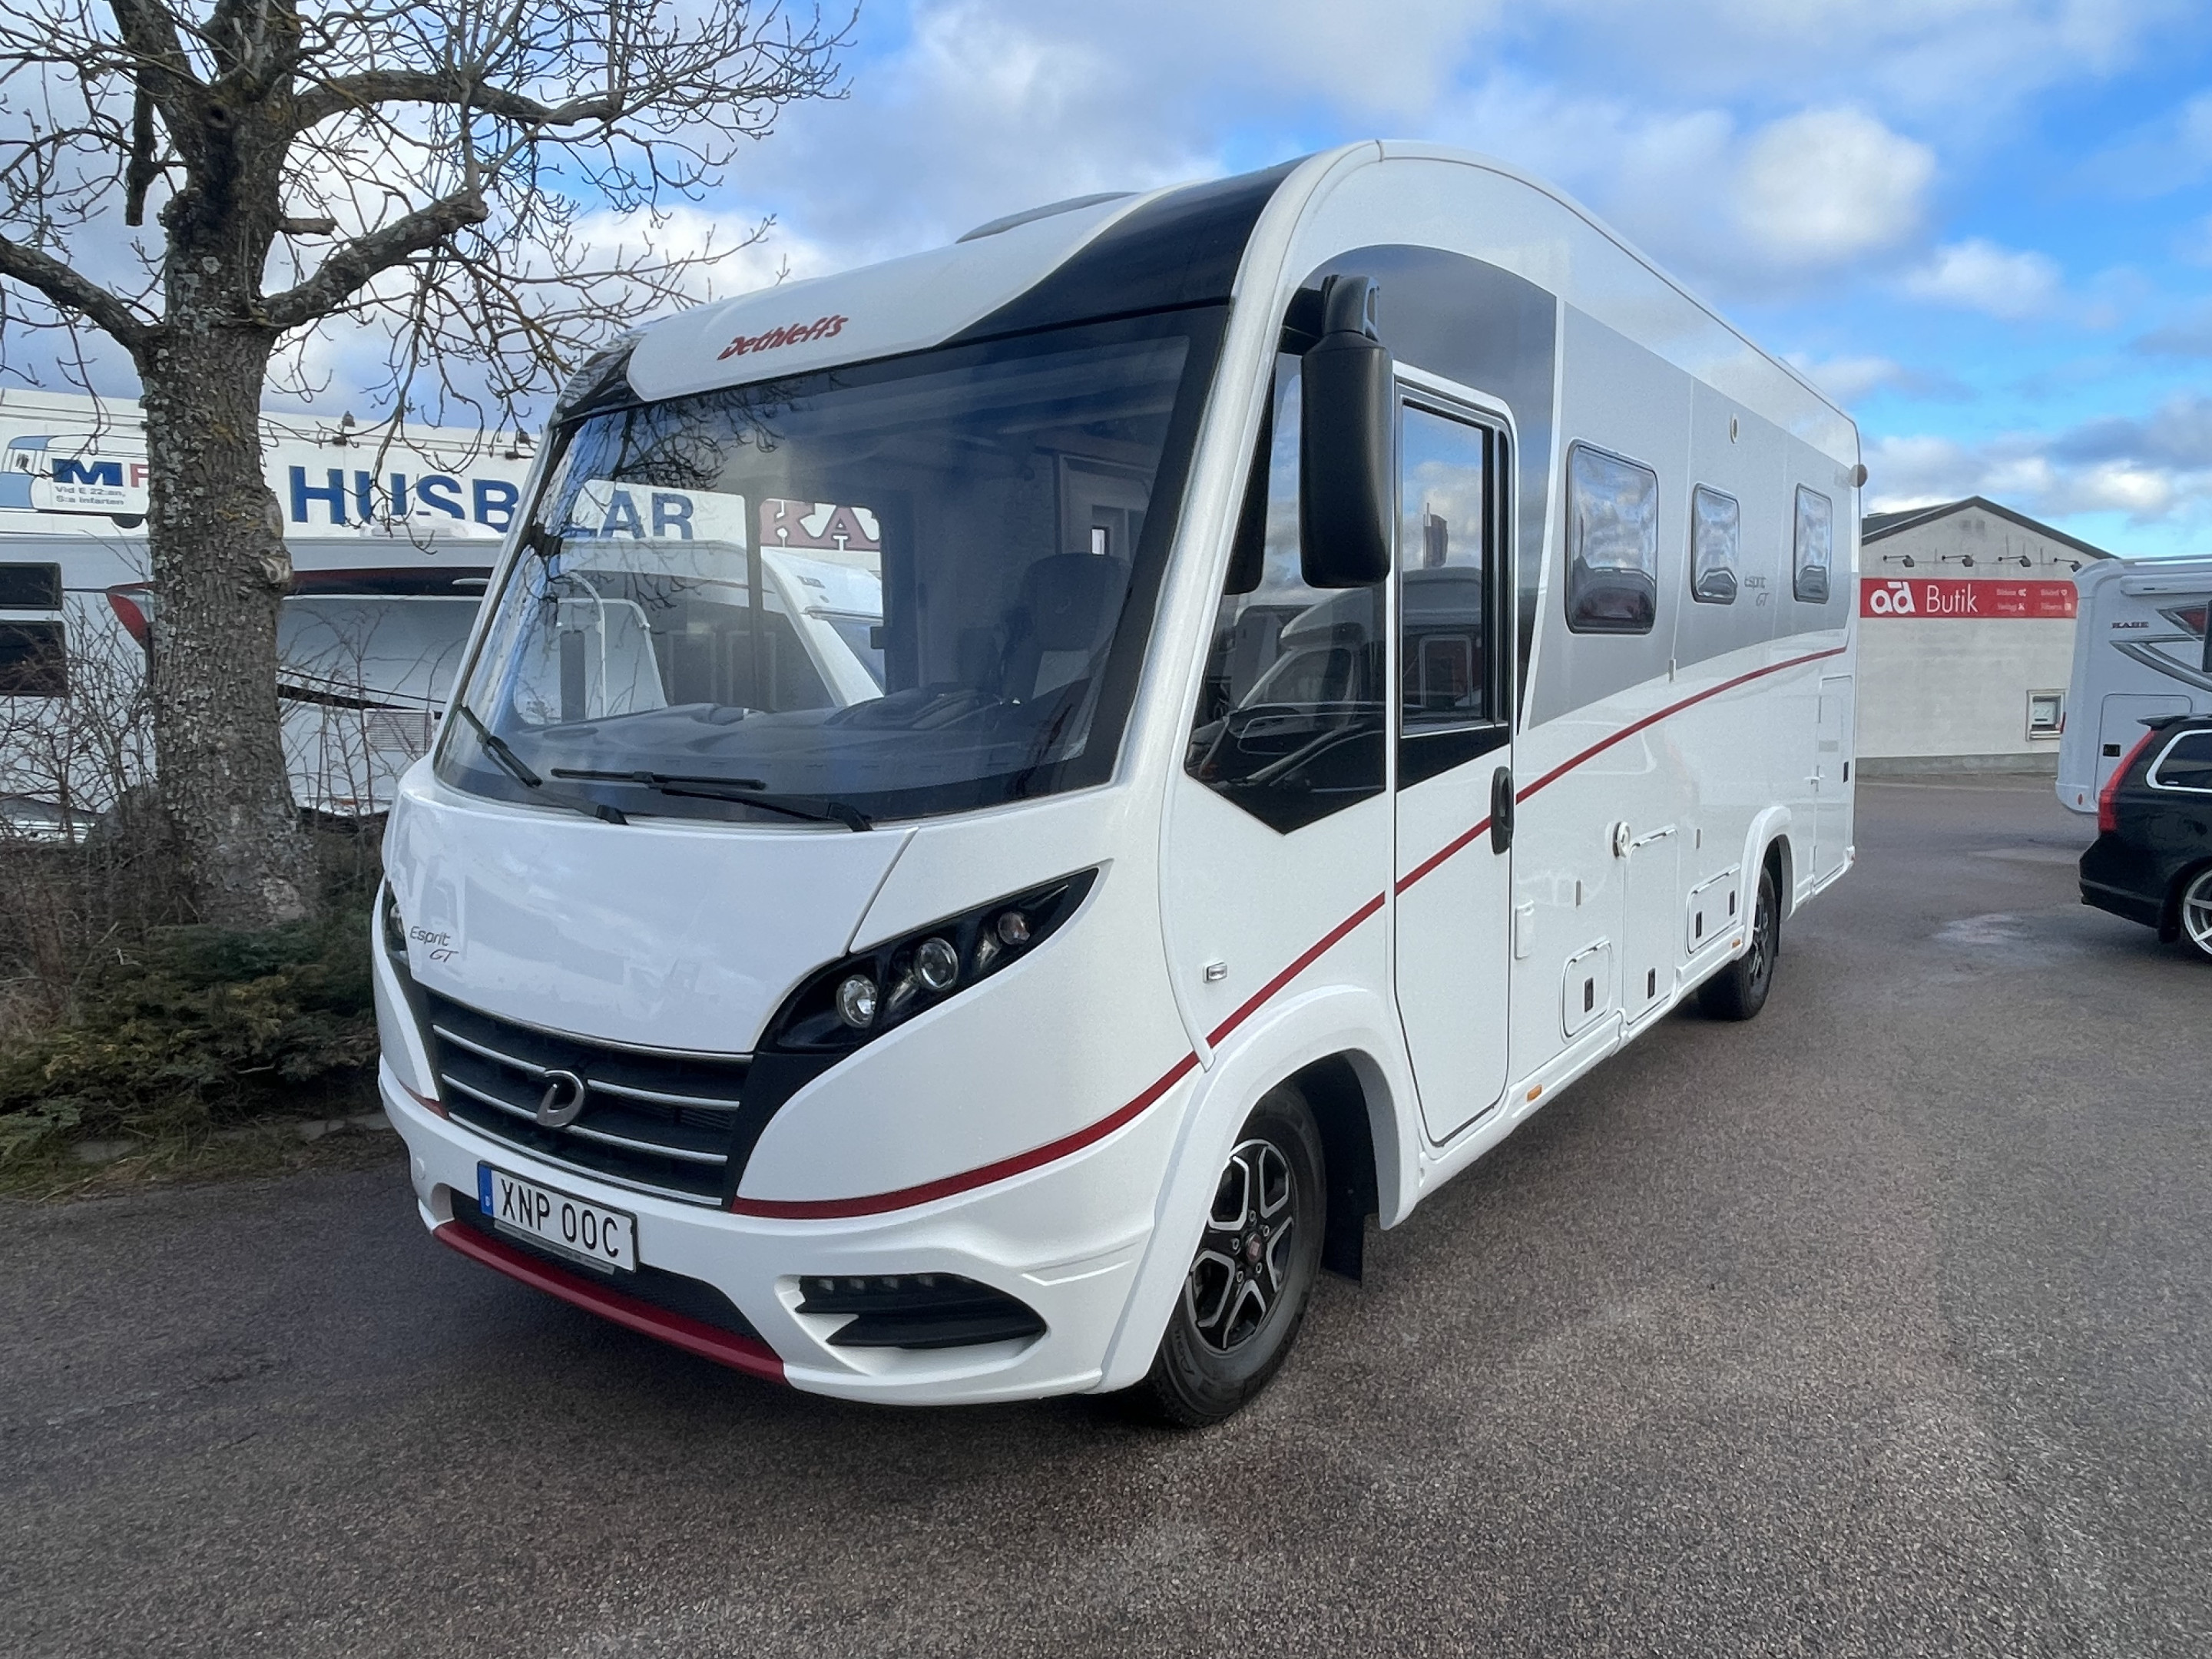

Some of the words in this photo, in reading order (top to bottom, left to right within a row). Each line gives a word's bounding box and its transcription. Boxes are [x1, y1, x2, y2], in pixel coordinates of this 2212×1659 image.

[717, 315, 849, 360] Dethleffs
[1926, 583, 1979, 613] Butik
[409, 926, 451, 947] Esprit
[429, 949, 460, 962] GT
[501, 1178, 550, 1230] XNP
